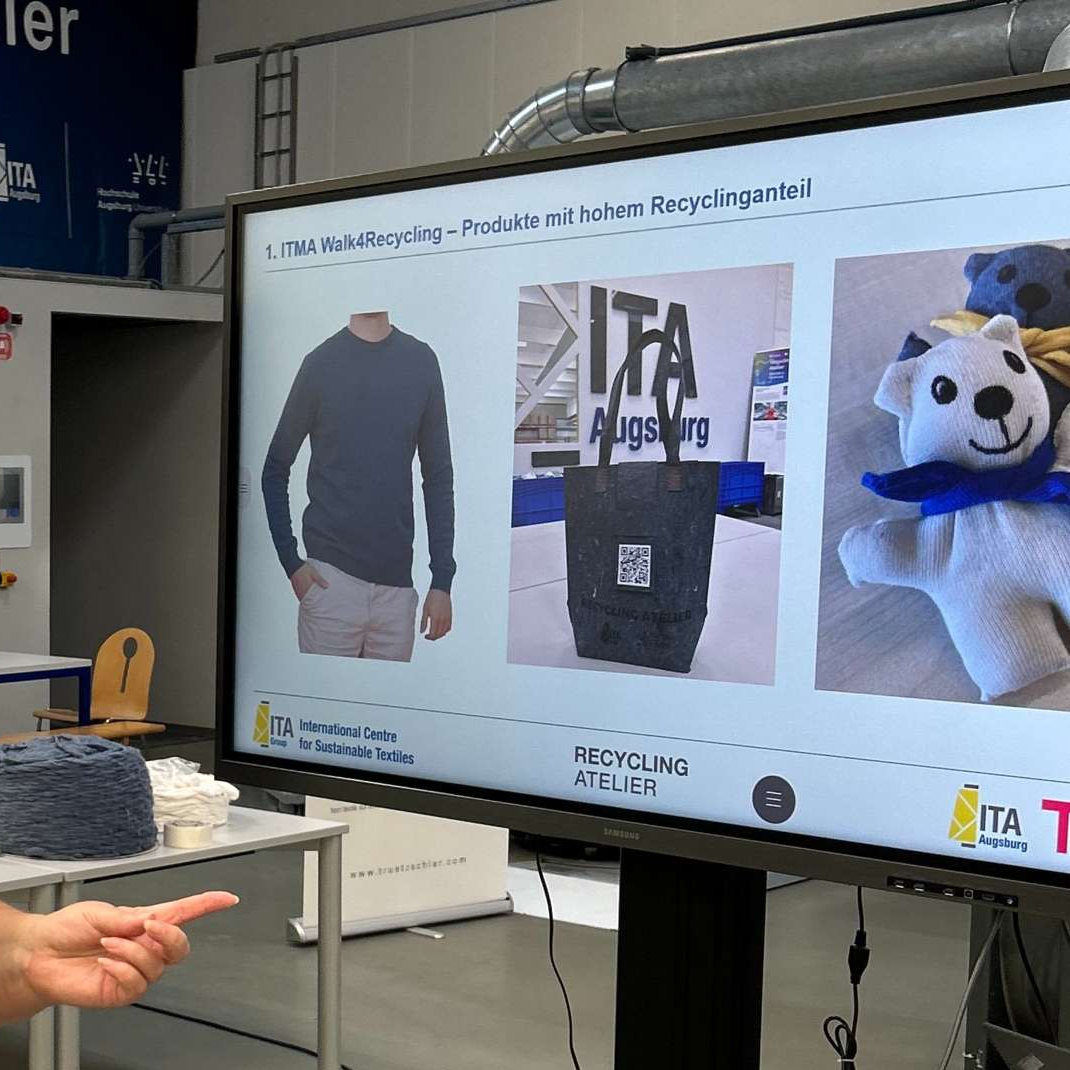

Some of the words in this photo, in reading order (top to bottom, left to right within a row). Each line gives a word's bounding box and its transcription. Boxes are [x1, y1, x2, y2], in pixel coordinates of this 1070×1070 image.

[7, 160, 37, 190] ITA
[266, 243, 277, 260] 1.
[281, 238, 317, 258] ITMA
[321, 224, 442, 254] Walk4Recycling
[462, 212, 540, 236] Produkte
[545, 206, 575, 228] mit
[579, 200, 644, 224] hohem
[651, 177, 812, 217] Recyclinganteil
[590, 285, 698, 399] ITA
[270, 715, 295, 738] ITA
[299, 718, 362, 739] International
[363, 726, 398, 743] Centre
[299, 736, 313, 750] for
[314, 739, 373, 759] Sustainable
[374, 747, 415, 765] Textiles
[574, 745, 689, 777] RECYCLING
[573, 769, 658, 797] ATELIER
[603, 827, 640, 841] SAMSUNG
[979, 804, 1022, 836] ITA
[978, 834, 1028, 853] Augsburg
